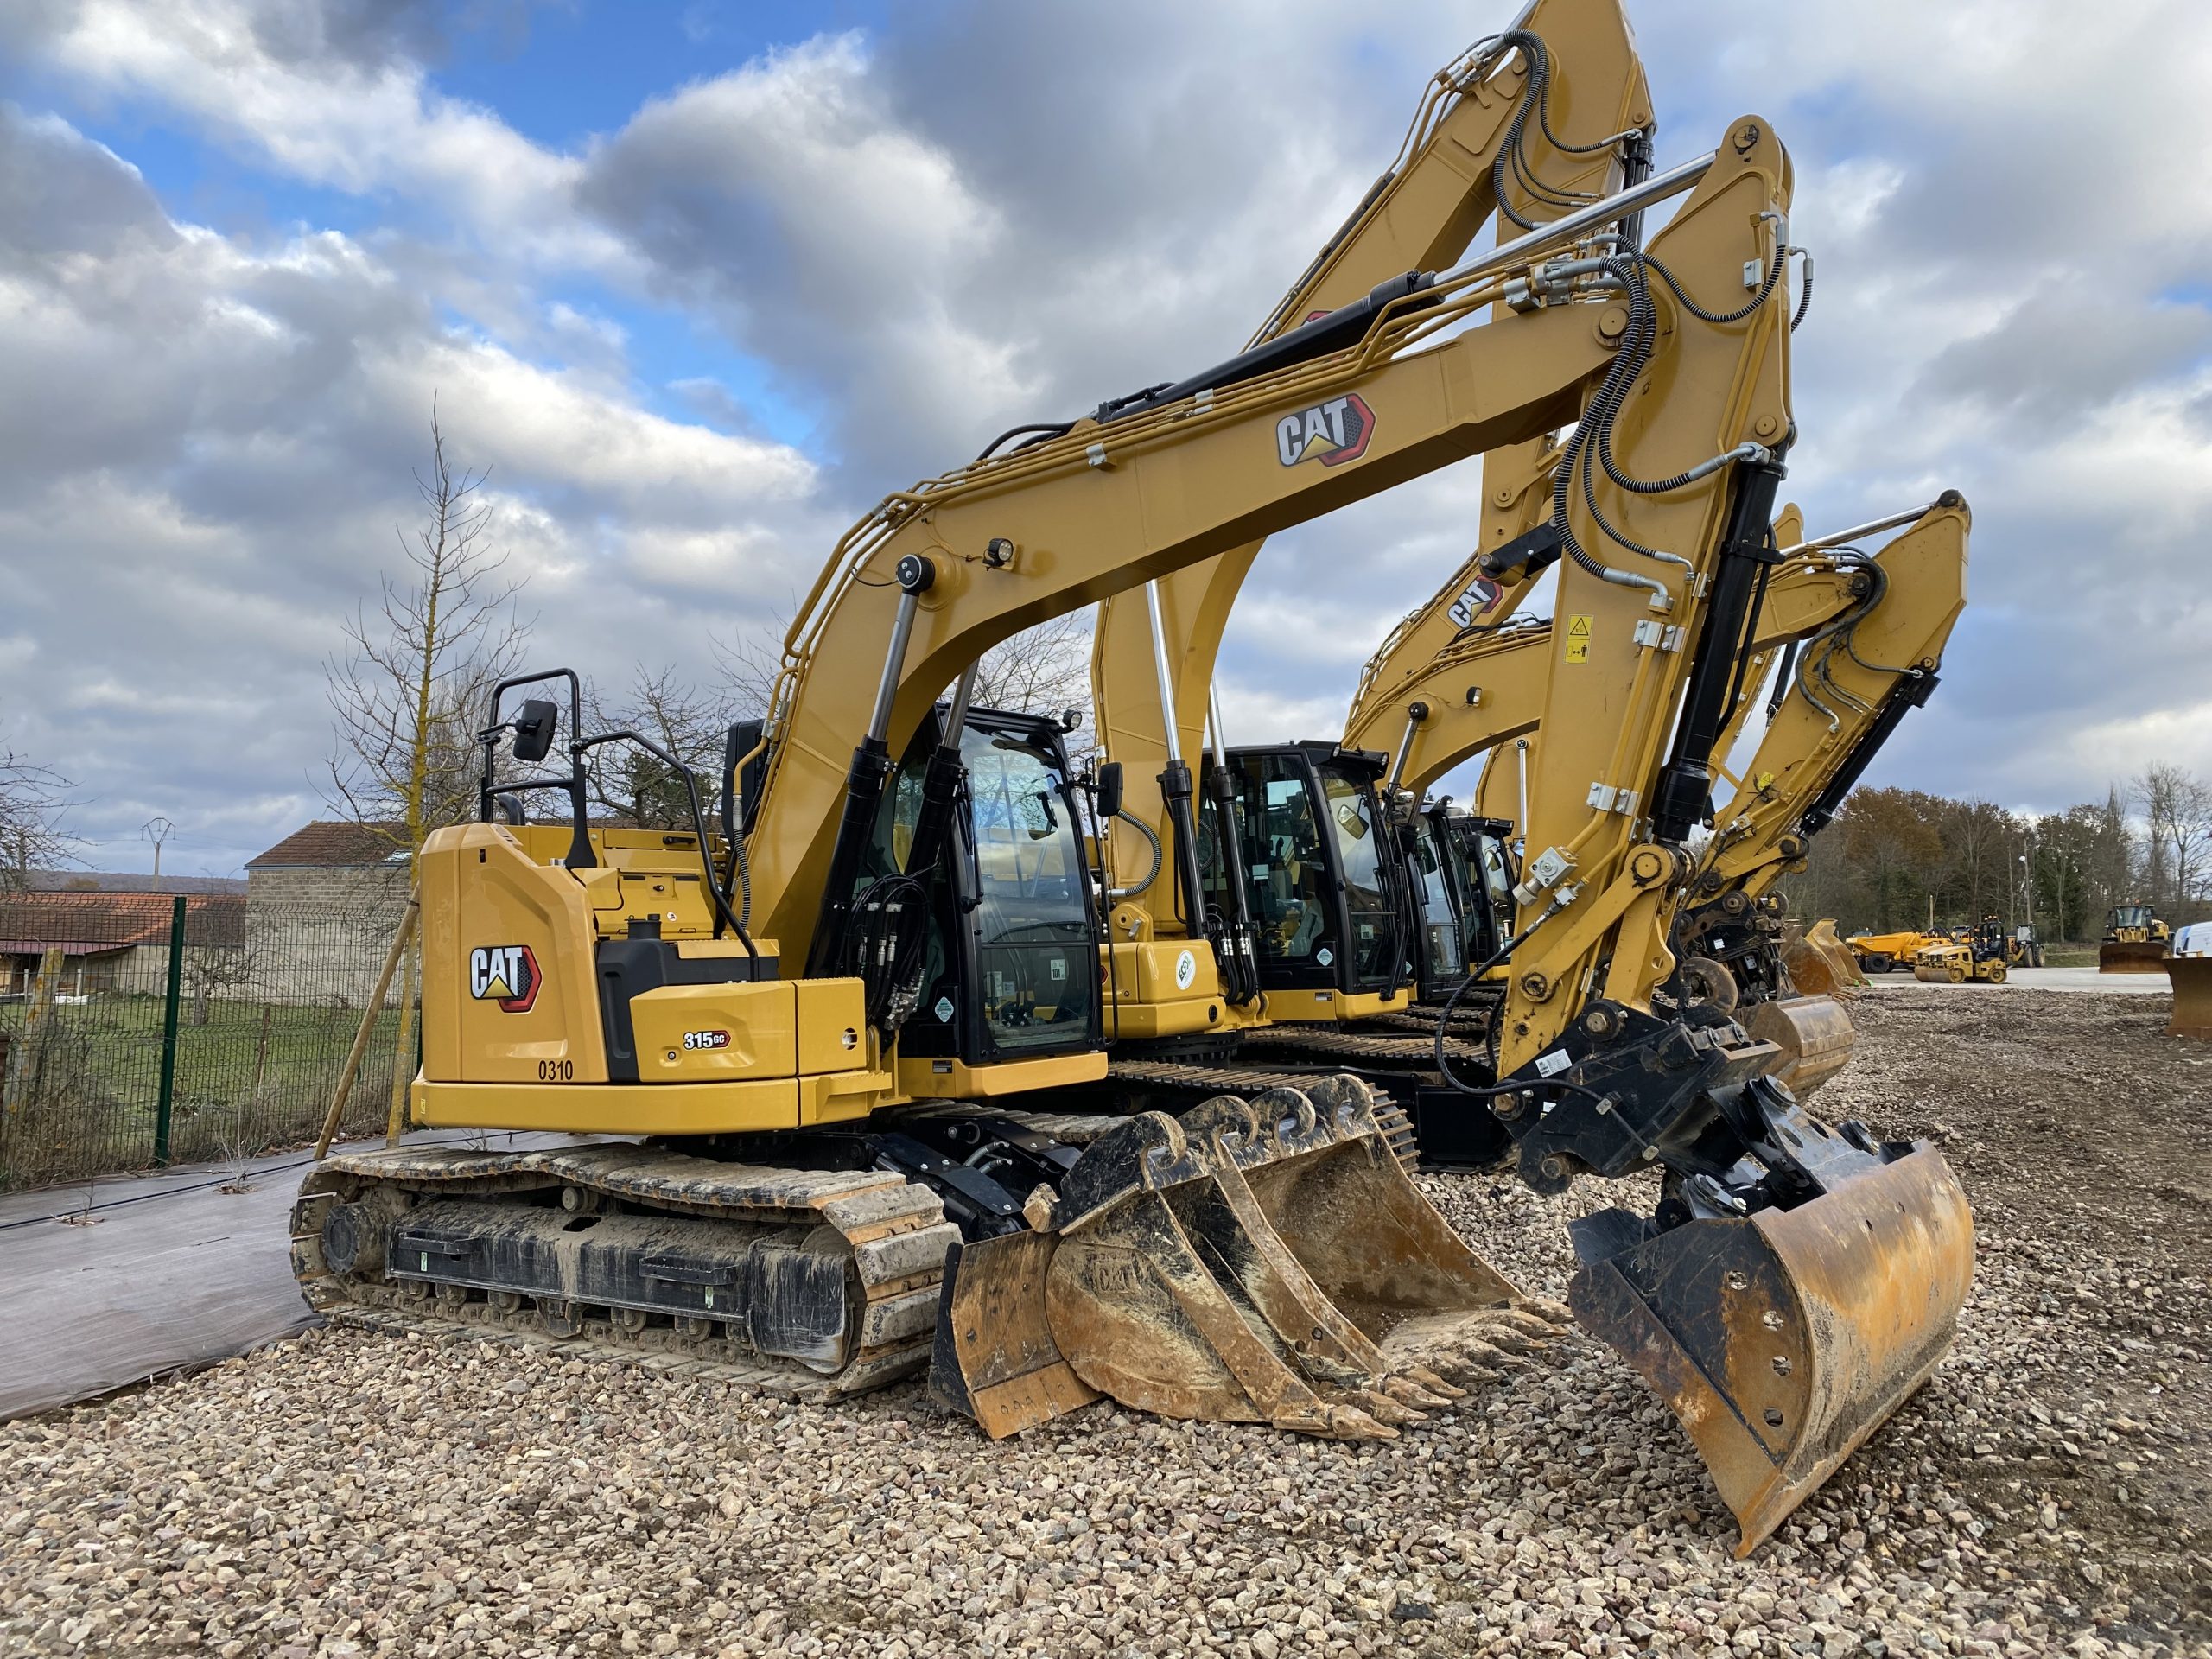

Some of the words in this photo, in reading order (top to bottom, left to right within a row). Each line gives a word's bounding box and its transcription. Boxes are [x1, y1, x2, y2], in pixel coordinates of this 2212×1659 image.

[1277, 397, 1348, 466] CAT
[1448, 580, 1491, 628] CAT
[471, 947, 523, 998] CAT
[538, 1059, 574, 1081] 0310
